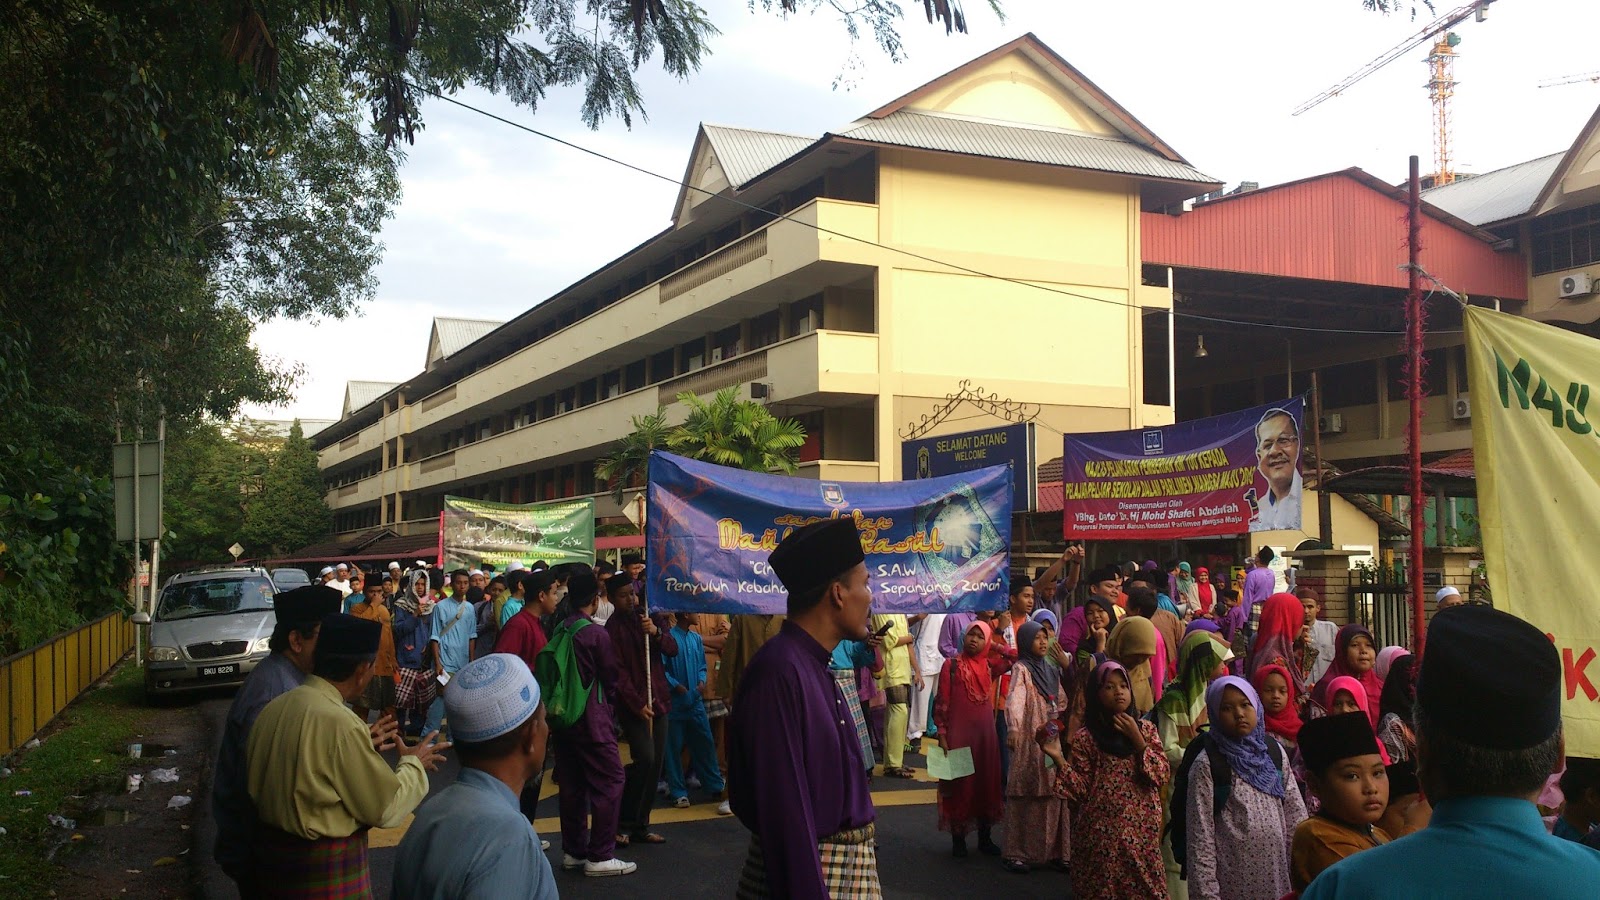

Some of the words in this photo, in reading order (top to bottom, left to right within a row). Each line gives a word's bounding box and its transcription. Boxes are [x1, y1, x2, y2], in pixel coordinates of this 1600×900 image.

[936, 437, 972, 453] SELAMAT
[973, 432, 1007, 448] DATANG
[954, 449, 987, 461] WELCOME
[1198, 447, 1229, 469] KEPADA
[1111, 480, 1141, 498] SEKOLAH
[1160, 476, 1193, 496] PARLIMEN
[1168, 499, 1183, 508] Oleh
[1075, 512, 1097, 523] YBhg.
[1130, 511, 1140, 523] Hj
[1141, 510, 1166, 520] Mohd
[1167, 507, 1196, 519] Shafei
[750, 560, 776, 576] "Cin
[878, 563, 917, 577] S.A.W
[664, 577, 730, 595] Penyuluh
[737, 579, 789, 595] Kebaha
[881, 581, 953, 596] Sepanjang
